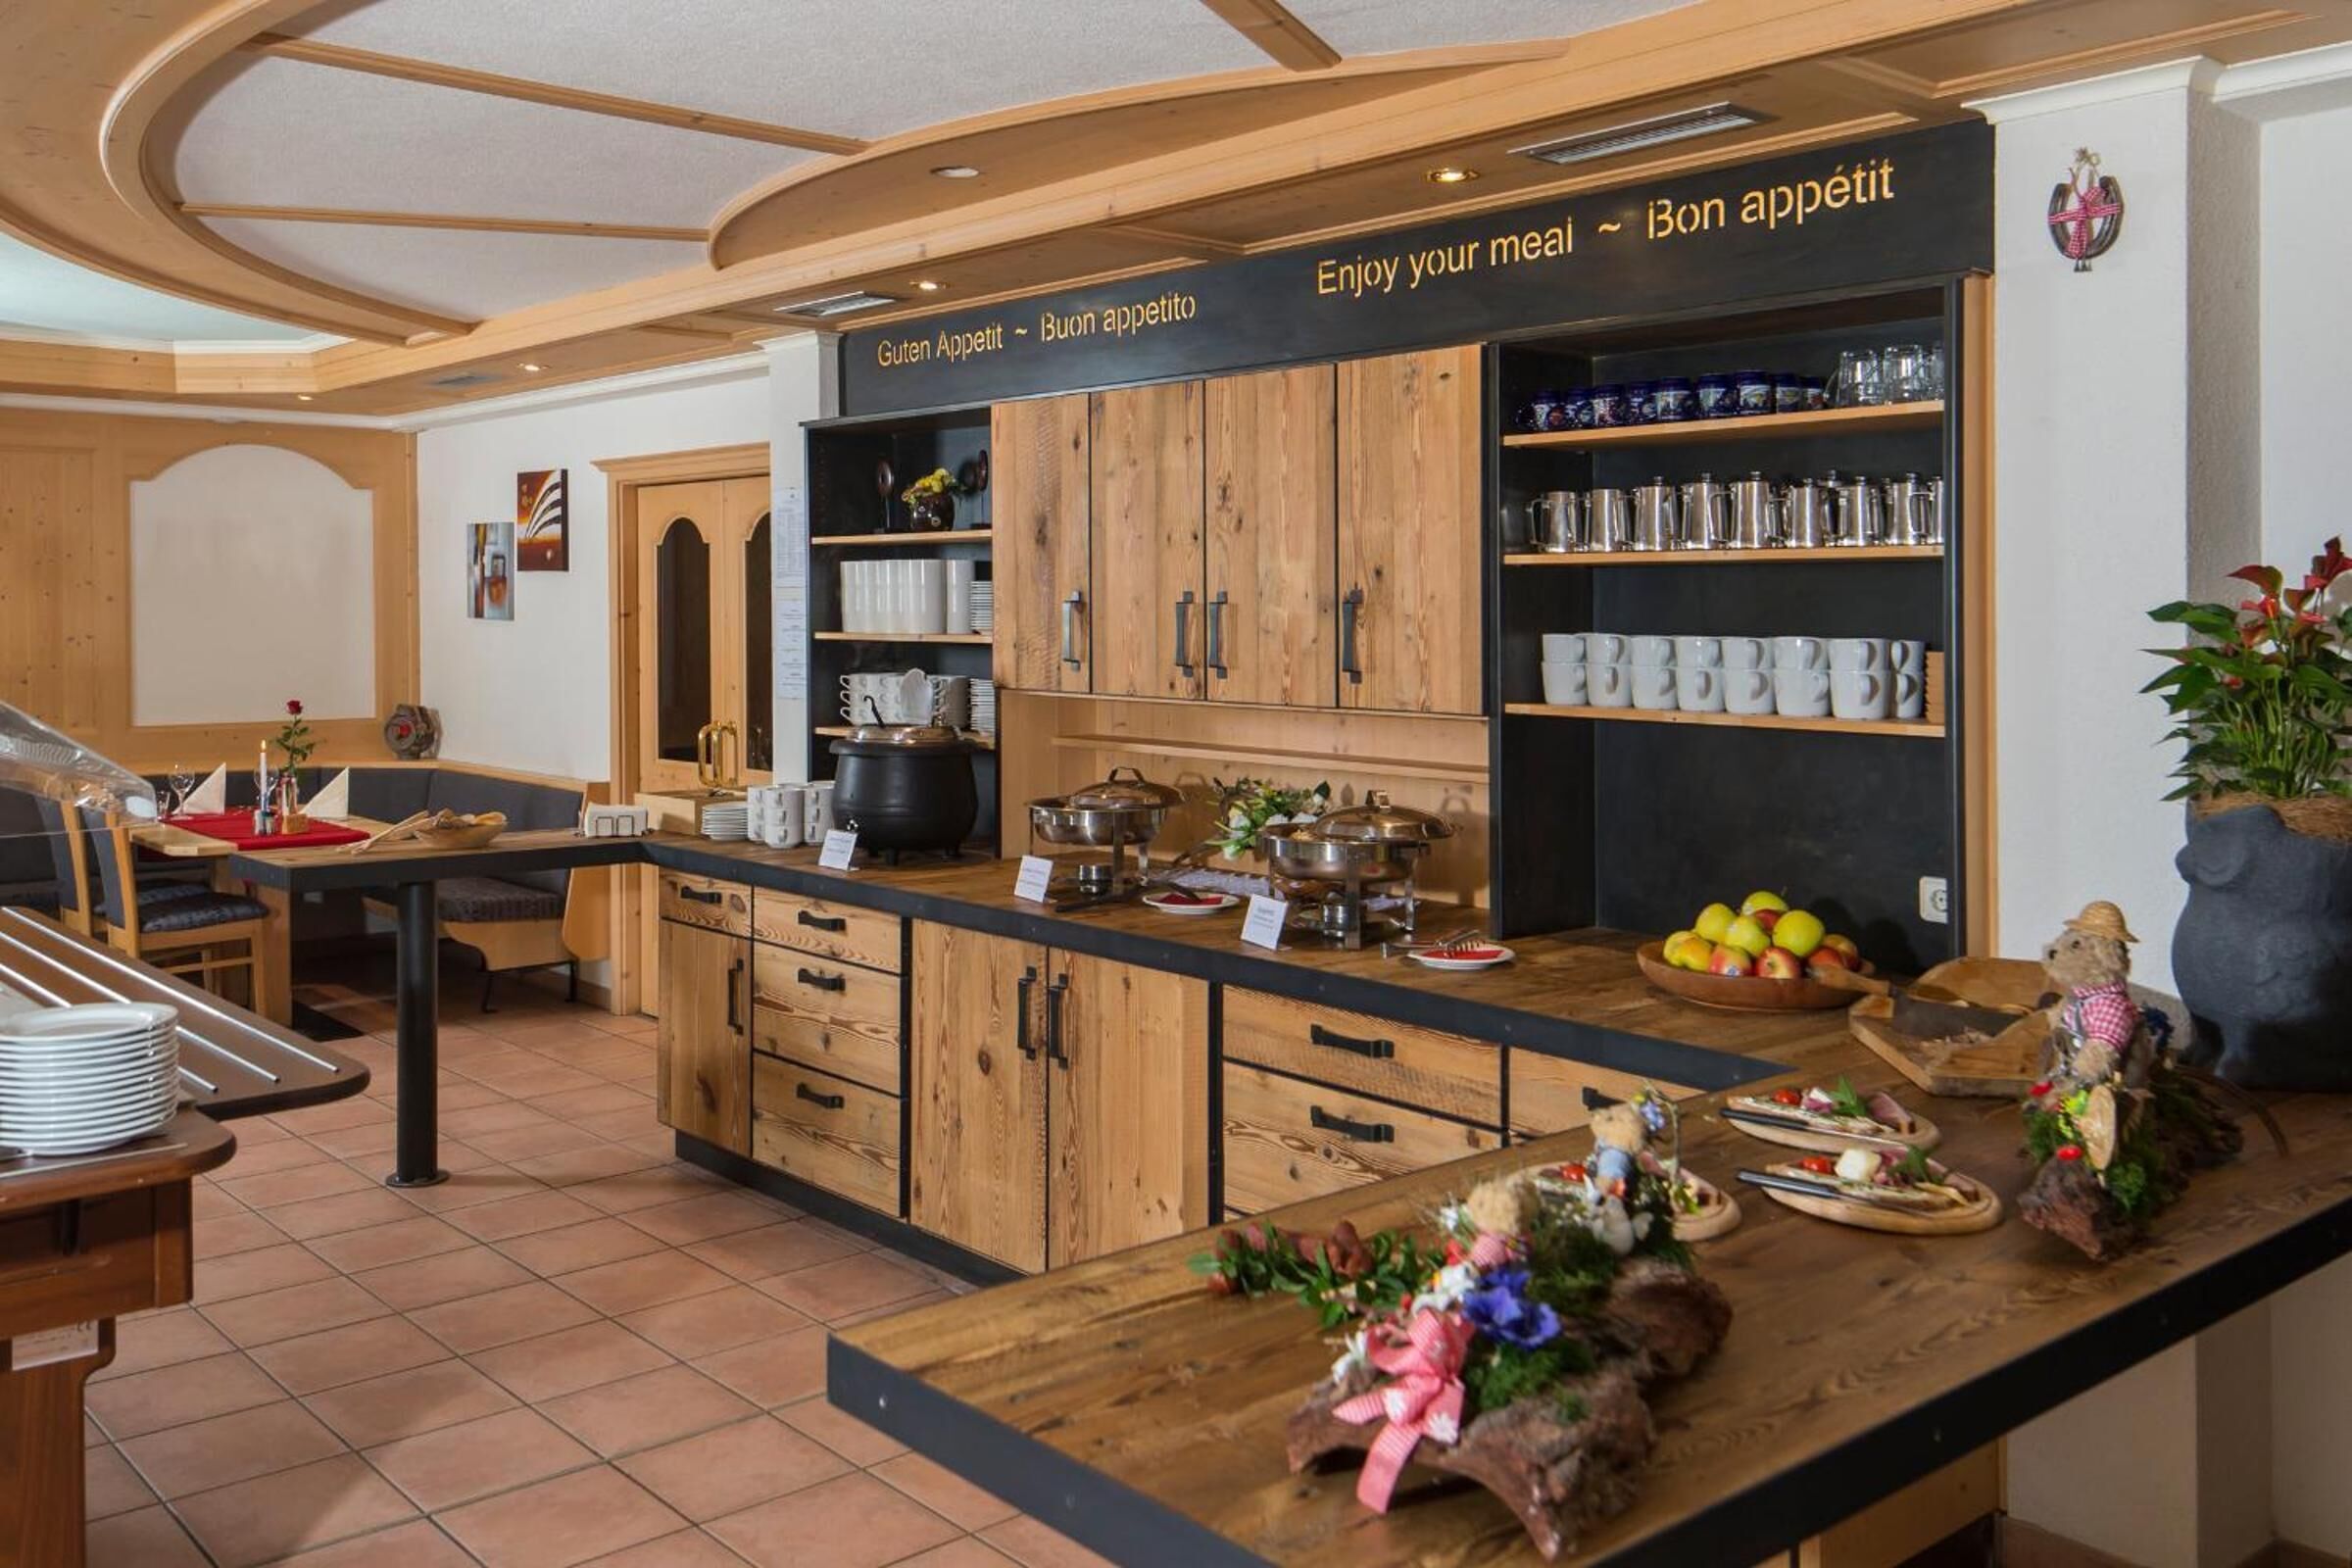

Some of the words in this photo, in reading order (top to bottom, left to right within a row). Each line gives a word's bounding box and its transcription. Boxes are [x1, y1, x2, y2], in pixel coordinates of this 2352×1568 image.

[1316, 256, 1399, 298] Enjoy
[1408, 241, 1480, 288] your
[1489, 216, 1573, 265] meal
[1646, 198, 1726, 238] Bon
[1740, 158, 1895, 230] appétit
[876, 340, 931, 367] Guten
[936, 324, 1004, 364] Appetit
[1040, 312, 1097, 342] Buon
[1102, 292, 1198, 336] appetito
